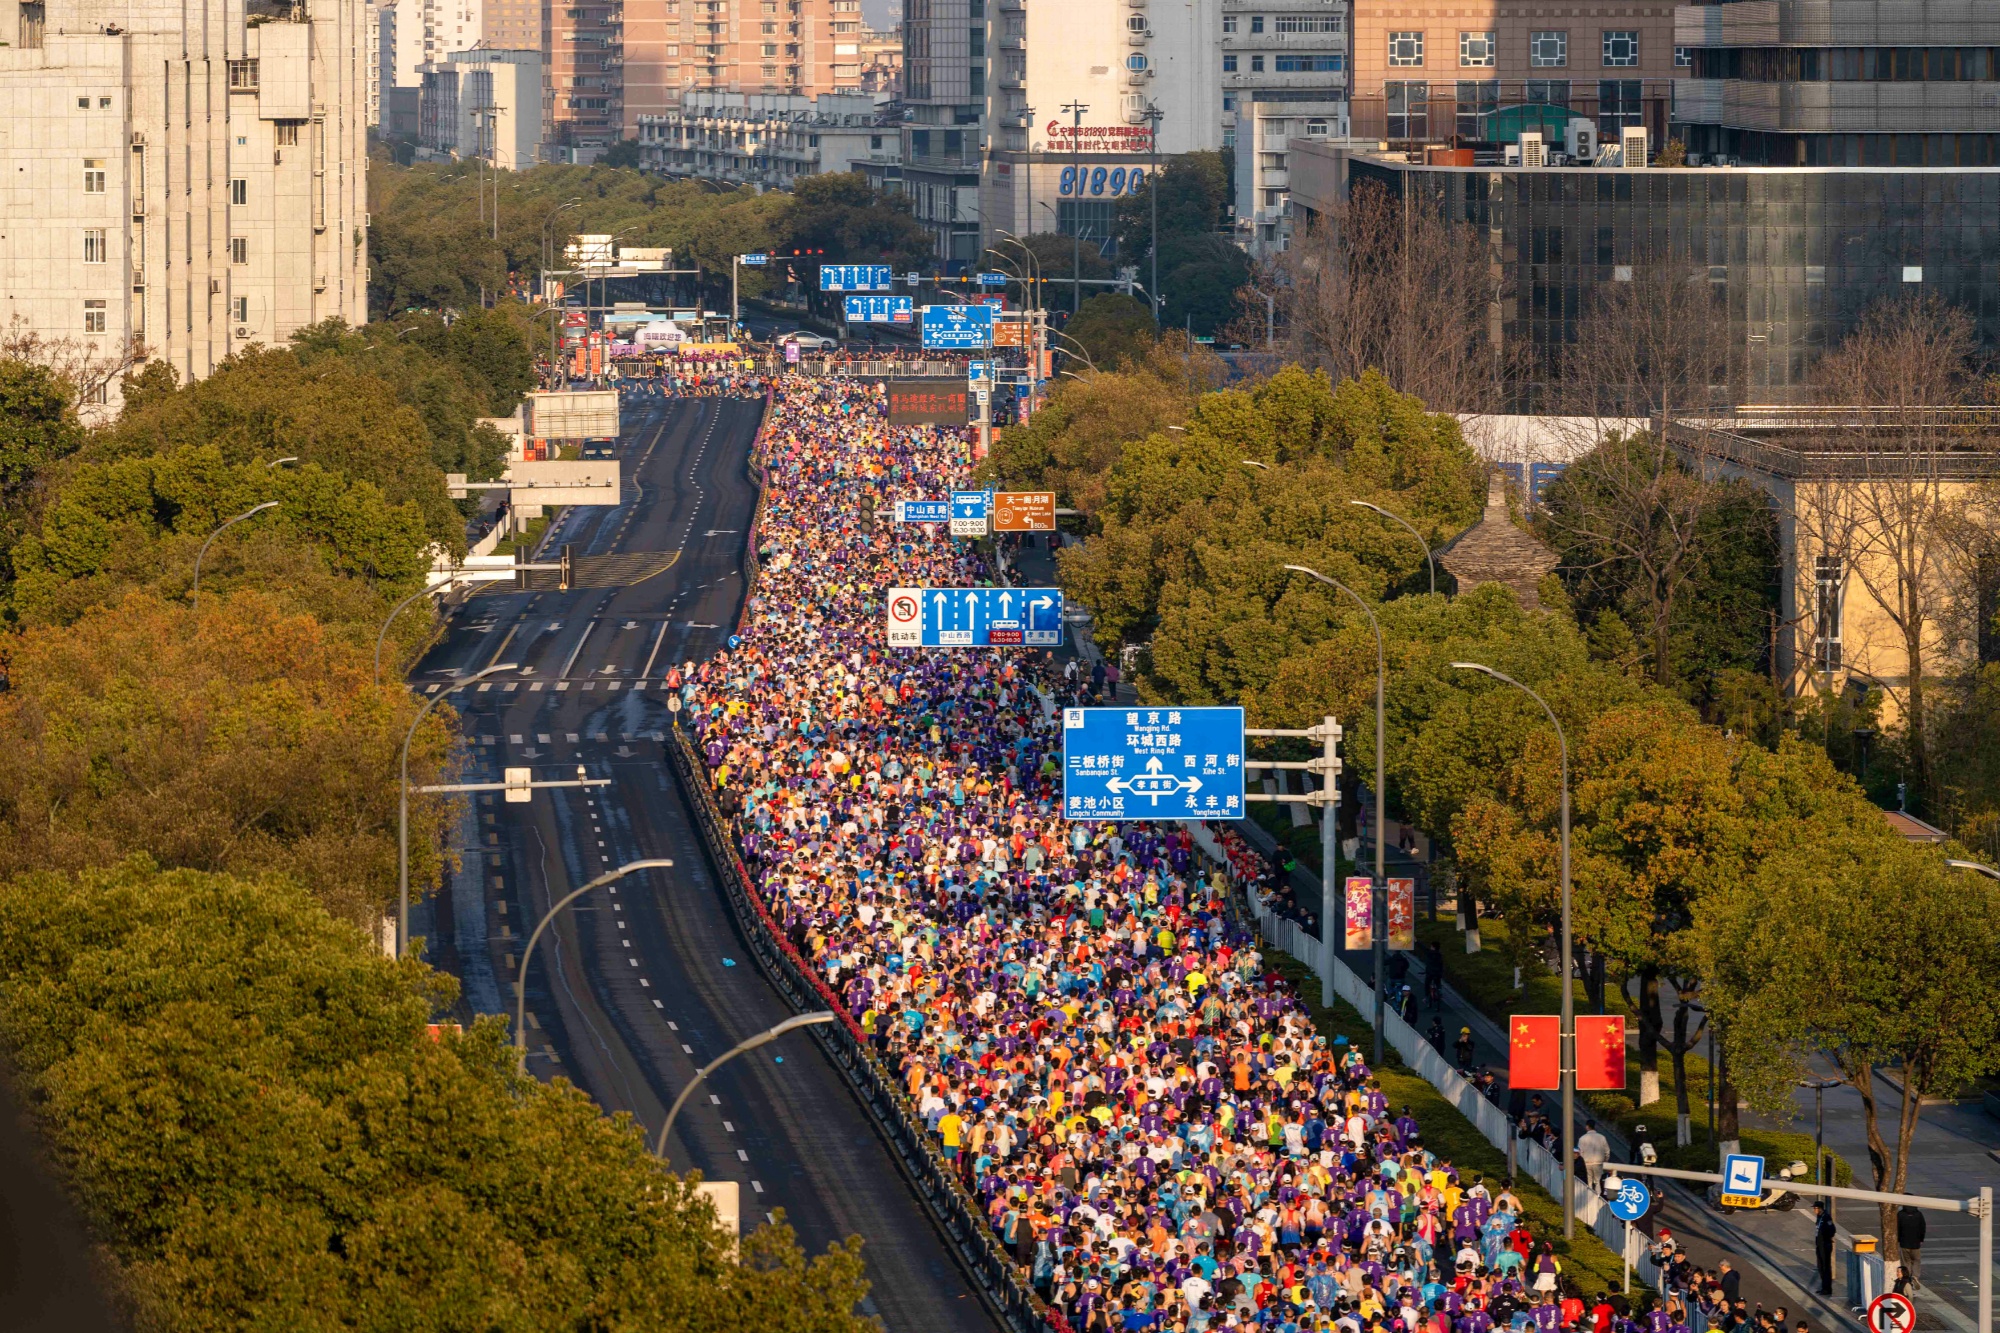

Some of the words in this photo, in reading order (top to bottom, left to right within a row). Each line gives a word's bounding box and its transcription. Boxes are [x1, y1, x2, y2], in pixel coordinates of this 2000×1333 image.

[1060, 166, 1145, 196] 81890
[906, 504, 947, 515] 中山西路
[891, 632, 918, 641] 机动车
[1069, 710, 1080, 721] 西
[1126, 711, 1182, 725] 望京路
[1134, 724, 1160, 733] Wangjing
[1126, 733, 1182, 747] 环城西路
[1134, 747, 1149, 755] West
[1150, 747, 1165, 756] Ring
[1069, 755, 1125, 768] 三板桥街
[1183, 754, 1241, 768] 西河街
[1075, 768, 1110, 778] Sanbanqiao
[1202, 767, 1217, 775] Xihe
[1137, 780, 1172, 790] 孝闻街
[1069, 796, 1125, 809] 菱池小区
[1185, 794, 1240, 809] 永丰路
[1069, 809, 1091, 818] Lingchi
[1092, 809, 1125, 818] Community
[1193, 808, 1221, 818] Yongfeng
[1724, 1195, 1758, 1207] 电子警察
